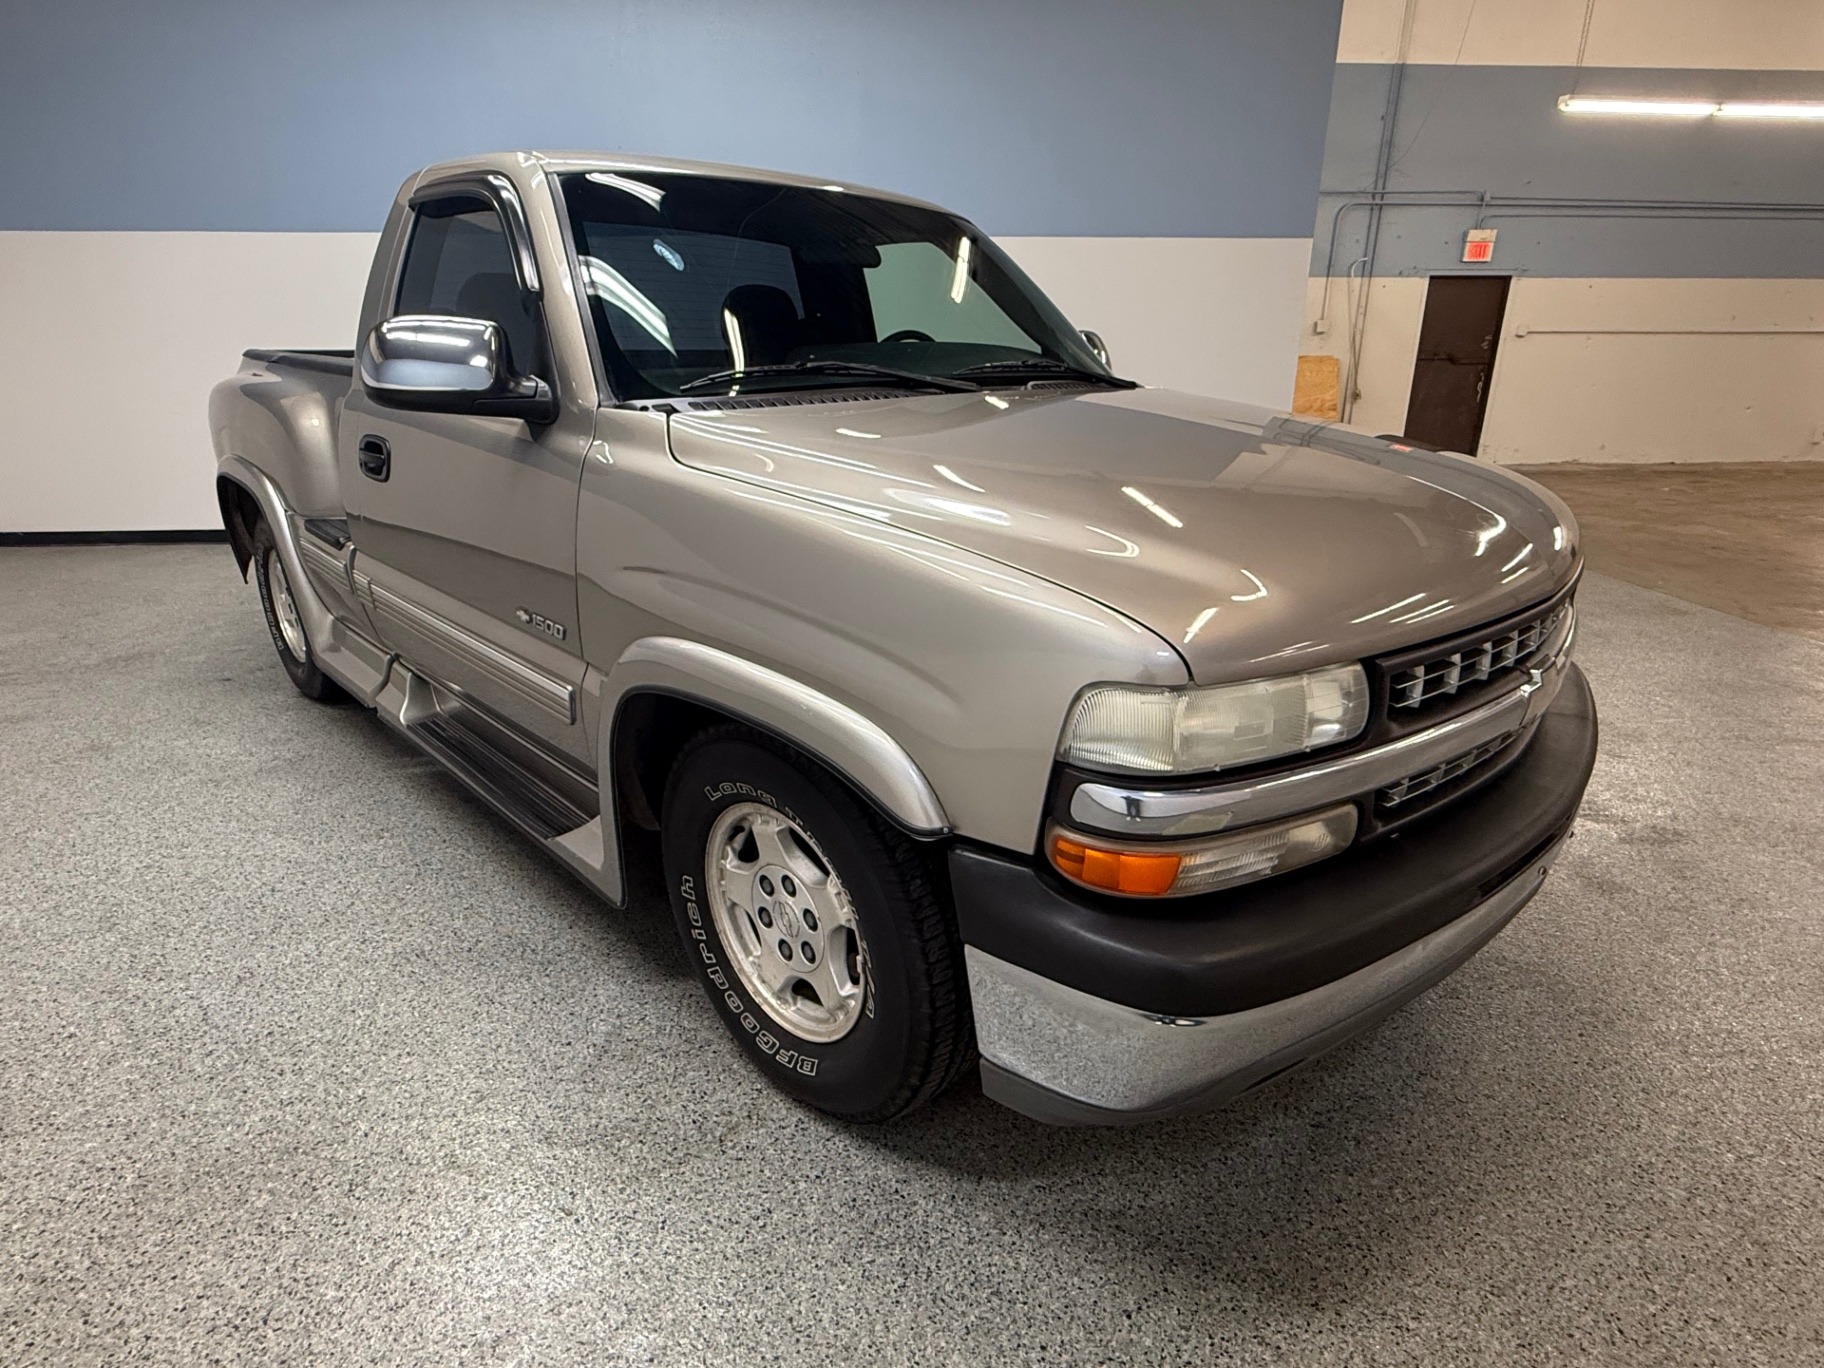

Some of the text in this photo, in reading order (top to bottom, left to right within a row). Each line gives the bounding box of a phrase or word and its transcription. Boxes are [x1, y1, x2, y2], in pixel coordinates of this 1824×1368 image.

[532, 614, 565, 640] 1500
[704, 782, 777, 808] Long
[680, 875, 819, 1077] BFGoodrich
